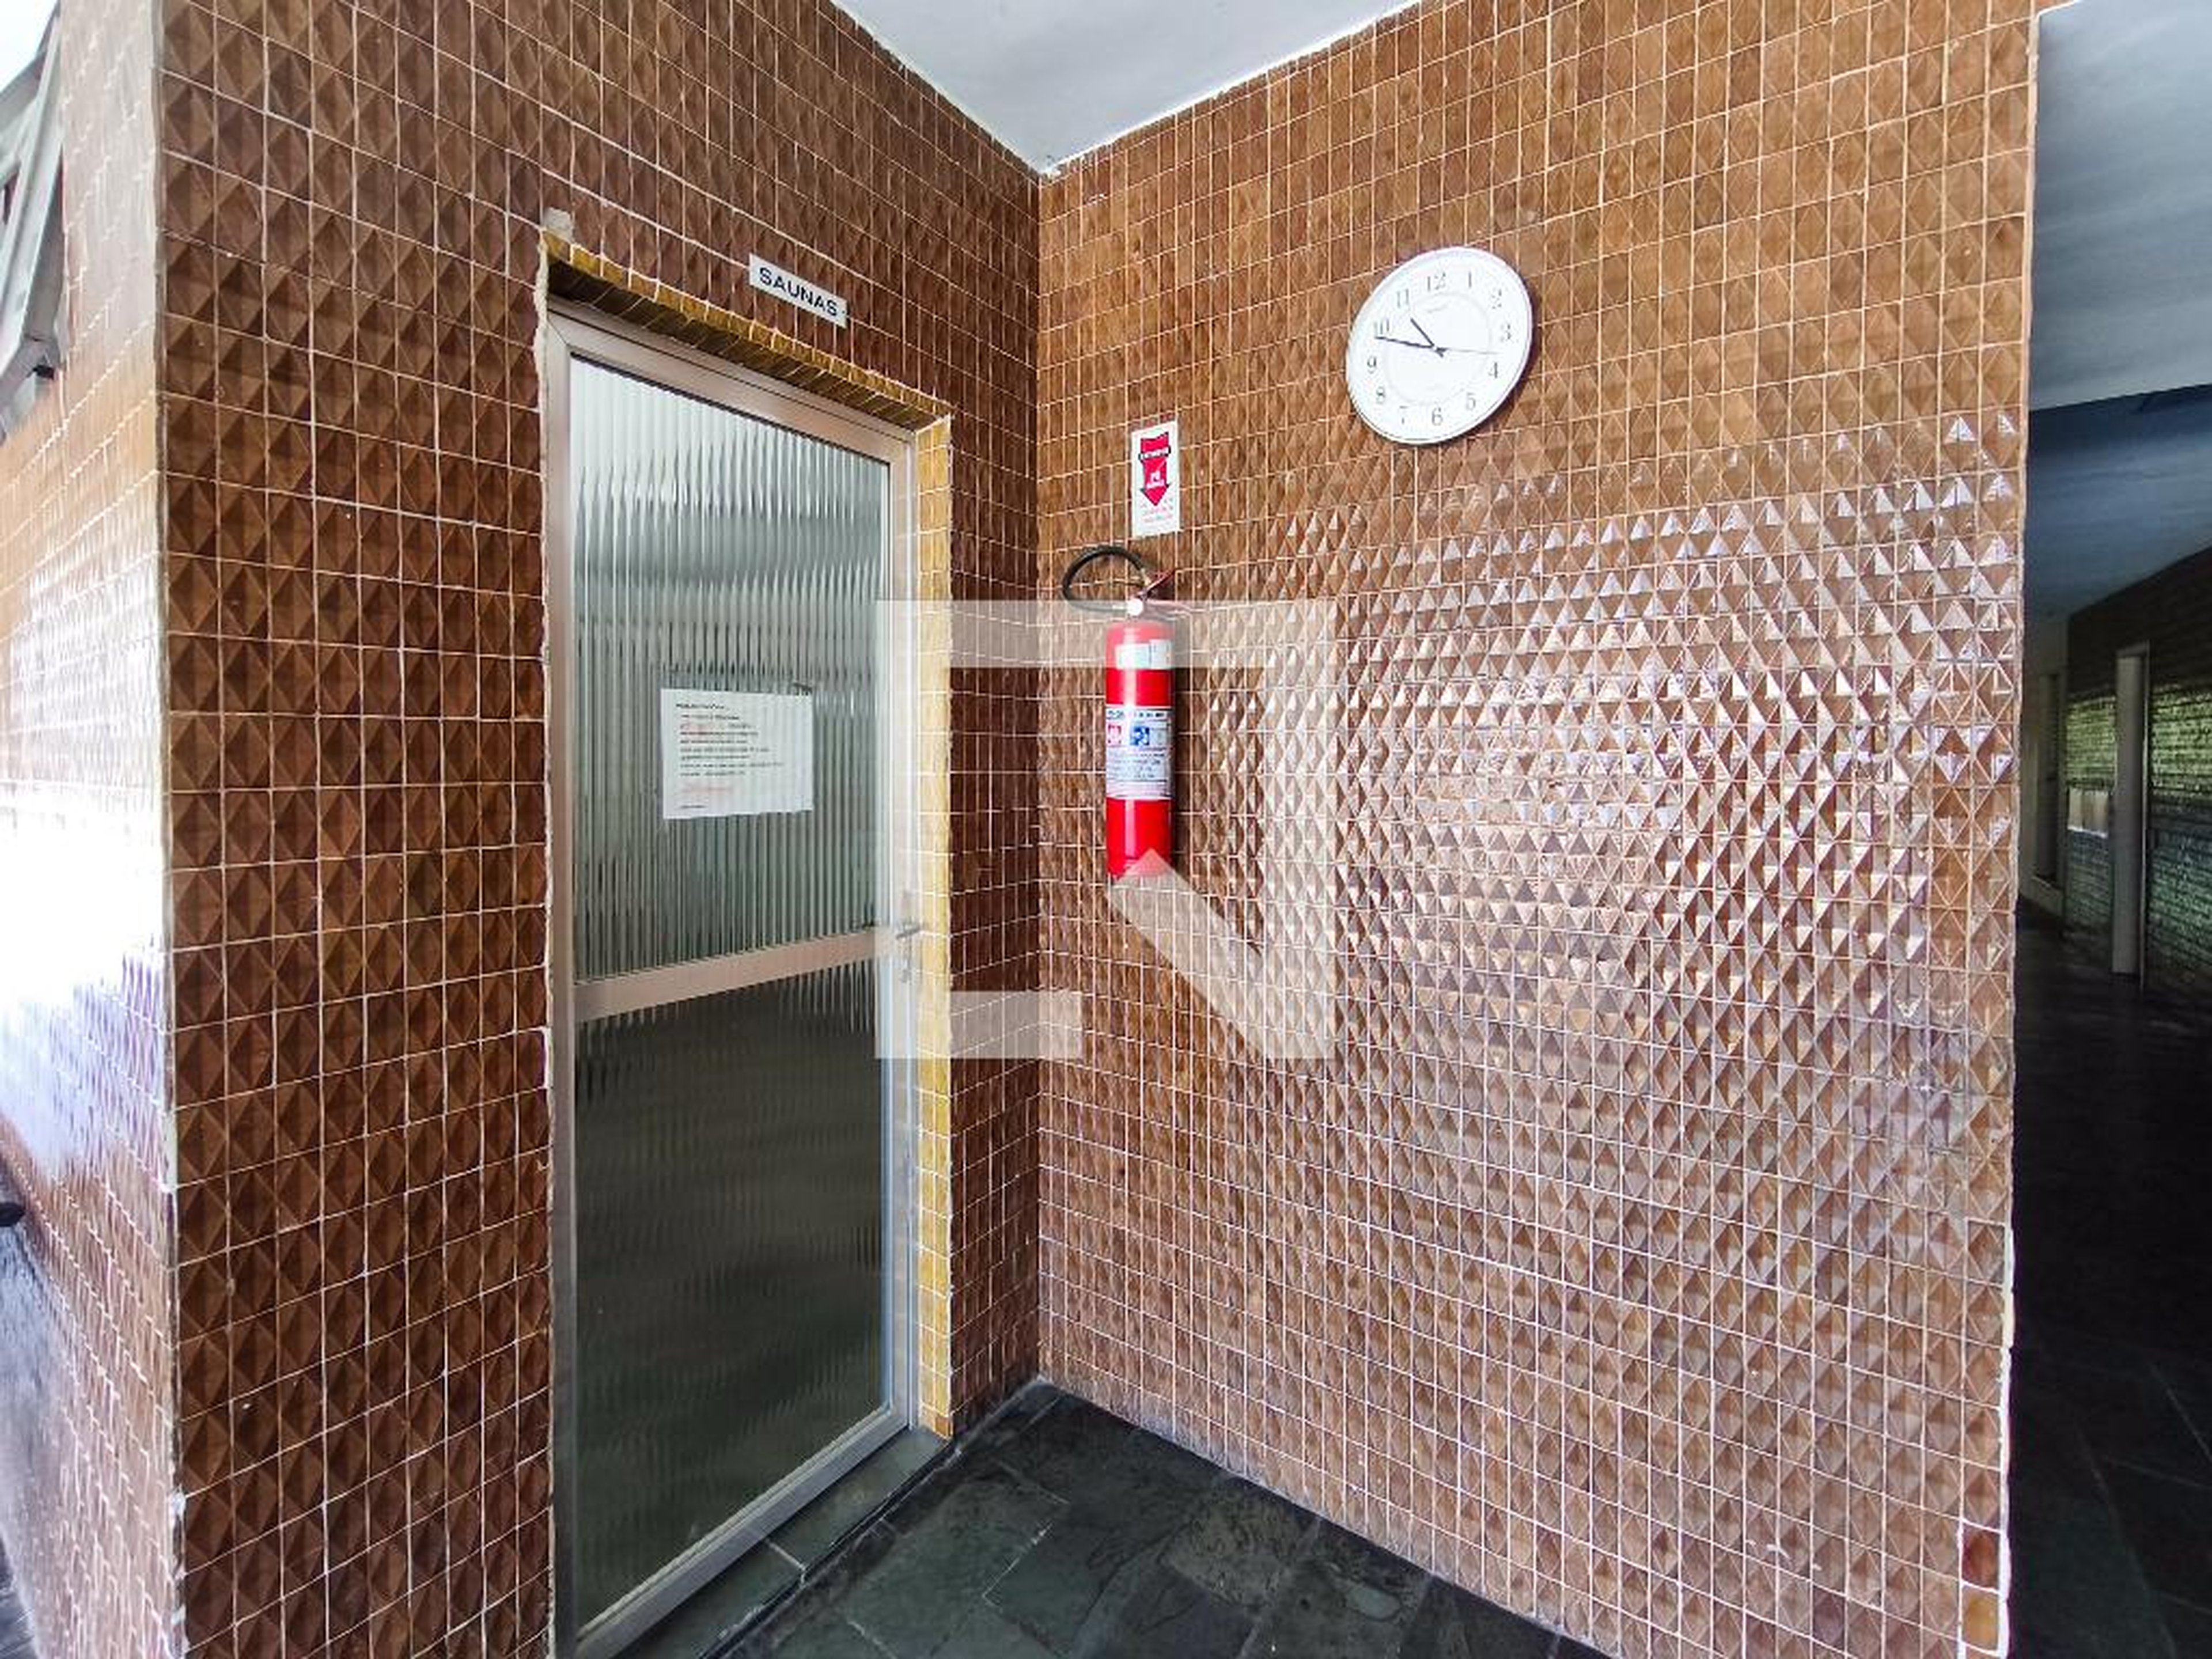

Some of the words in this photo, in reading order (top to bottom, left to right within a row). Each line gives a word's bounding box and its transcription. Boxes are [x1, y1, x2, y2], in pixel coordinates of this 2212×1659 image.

[1427, 272, 1446, 291] 12
[759, 267, 838, 316] SAUNAS
[1396, 288, 1410, 309] 11
[1366, 355, 1377, 374] 9
[1488, 362, 1498, 378] 4
[1376, 387, 1386, 405] 8
[1466, 392, 1476, 411] 5
[1431, 407, 1444, 426] 6
